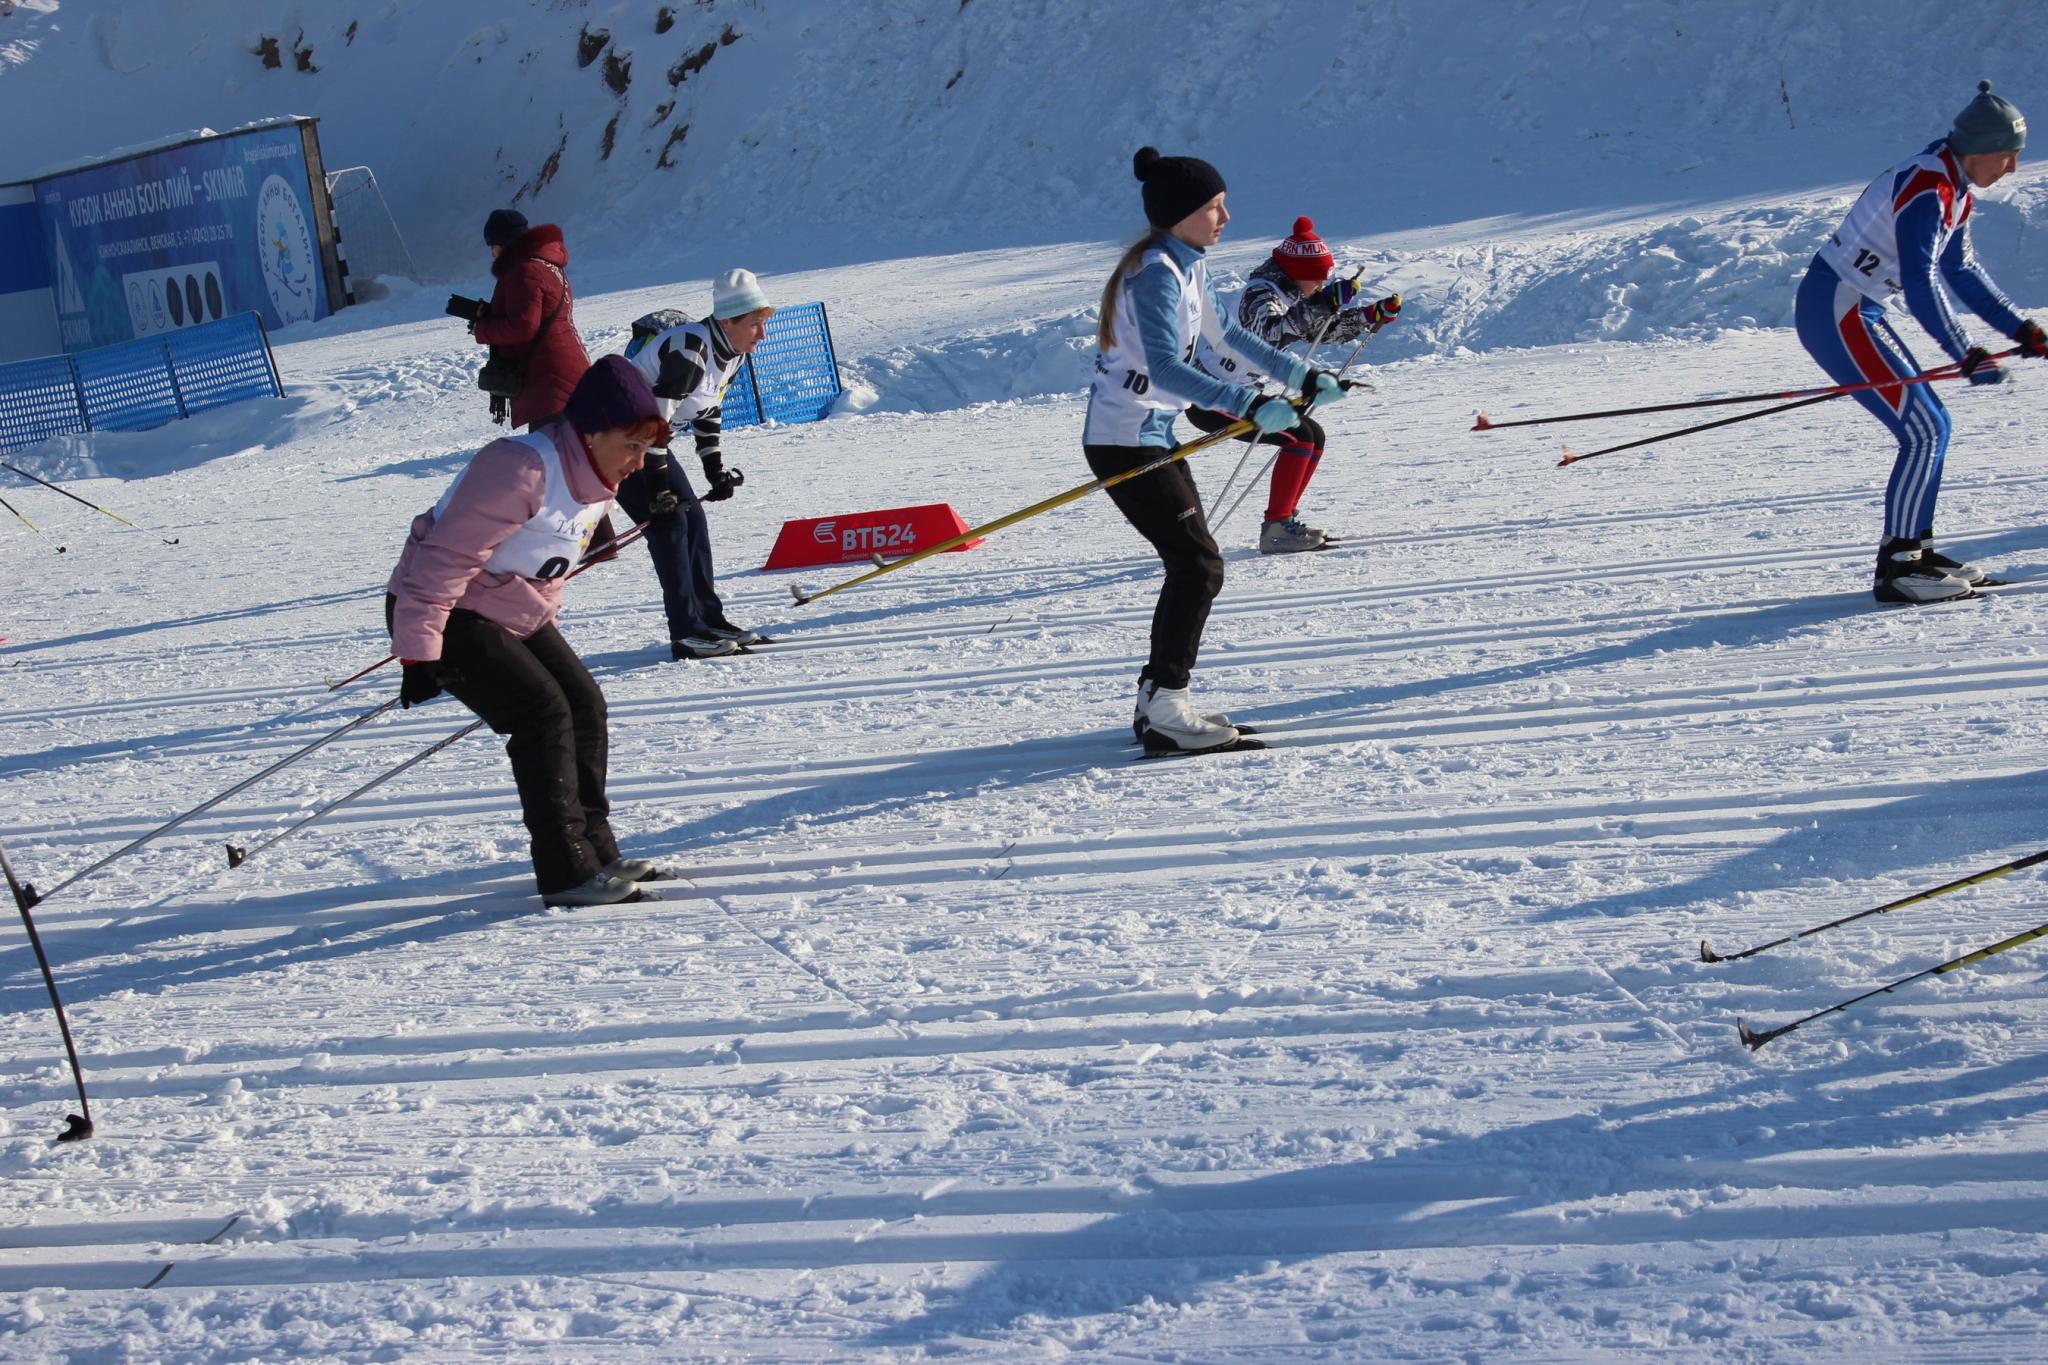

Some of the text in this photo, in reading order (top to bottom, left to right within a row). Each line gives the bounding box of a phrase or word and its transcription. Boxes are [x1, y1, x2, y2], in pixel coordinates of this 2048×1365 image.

[68, 195, 104, 227] КУБОК
[103, 187, 138, 221] АННЫ
[136, 166, 194, 214] БОГАЛИЙ
[1853, 248, 1880, 277] 12
[1123, 369, 1149, 395] 10
[842, 523, 916, 551] ВТБ24
